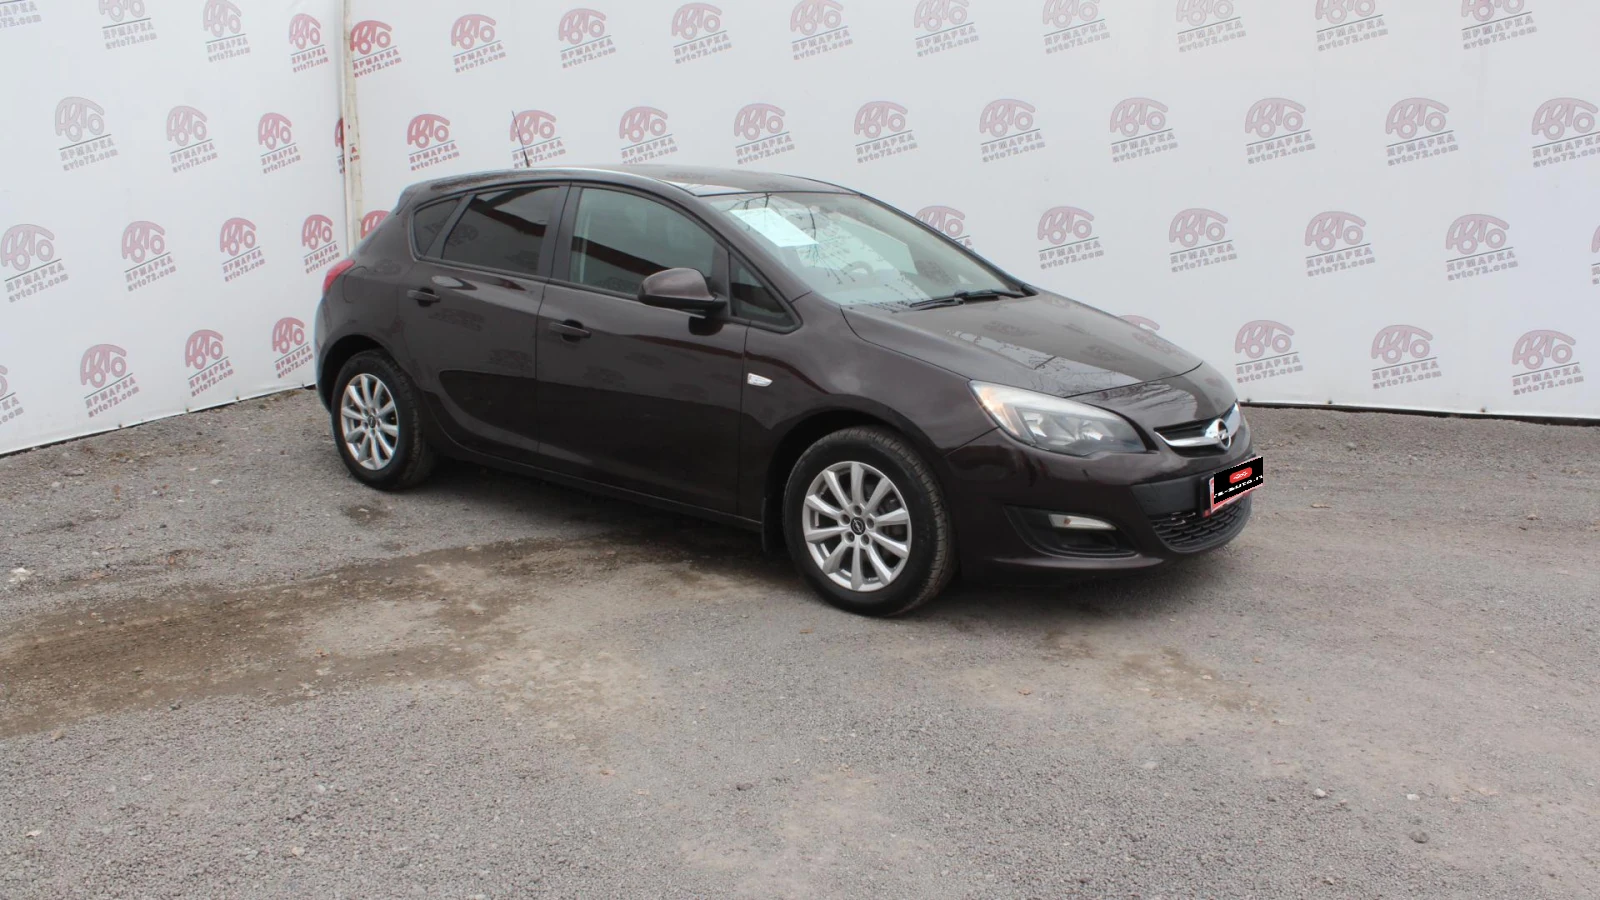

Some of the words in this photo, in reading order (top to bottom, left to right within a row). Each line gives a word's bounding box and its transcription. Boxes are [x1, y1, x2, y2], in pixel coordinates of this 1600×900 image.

[0, 1, 37, 16] АРКА
[103, 21, 154, 39] ЯРМАРКА
[916, 26, 976, 48] ЯРМАРКА
[1044, 22, 1107, 45] ЯРМАРКА
[1178, 21, 1243, 43] ЯРМАРКА
[1316, 18, 1385, 42] ЯРМАРКА
[1462, 15, 1534, 39] ЯРМАРКА
[206, 37, 248, 53] ЯРМАРКА
[561, 38, 613, 61] ЯРМАРКА
[674, 34, 729, 56] ЯРМАРКА
[792, 29, 850, 52] ЯРМАРКА
[291, 47, 326, 64] ЯРМАРКА
[353, 49, 399, 70] ЯРМАРКА
[454, 44, 503, 65] ЯРМАРКА
[60, 137, 114, 161] ЯРМАРКА
[170, 142, 215, 164] ЯРМАРКА
[409, 143, 457, 164] ЯРМАРКА
[621, 138, 674, 158] ЯРМАРКА
[736, 135, 792, 156] ЯРМАРКА
[856, 133, 914, 154] ЯРМАРКА
[981, 132, 1042, 154] ЯРМАРКА
[1111, 132, 1175, 154] ЯРМАРКА
[1247, 133, 1313, 155] ЯРМАРКА
[1387, 134, 1455, 157] ЯРМАРКА
[261, 146, 298, 165] ЯРМАРКА
[223, 249, 262, 273] ЯРМАРКА
[304, 244, 338, 266] ЯРМАРКА
[1039, 241, 1100, 261] ЯРМАРКА
[1170, 243, 1234, 264] ЯРМАРКА
[1306, 247, 1372, 268] ЯРМАРКА
[1447, 250, 1515, 272] ЯРМАРКА
[6, 262, 65, 292] ЯРМАРКА
[125, 256, 172, 282] ЯРМАРКА
[275, 345, 311, 371] ЯРМАРКА
[1236, 355, 1300, 374] ЯРМАРКА
[189, 360, 231, 388] ЯРМАРКА
[1372, 361, 1439, 380] ЯРМАРКА
[1513, 366, 1581, 386] ЯРМАРКА
[85, 376, 136, 409] ЯРМАРКА
